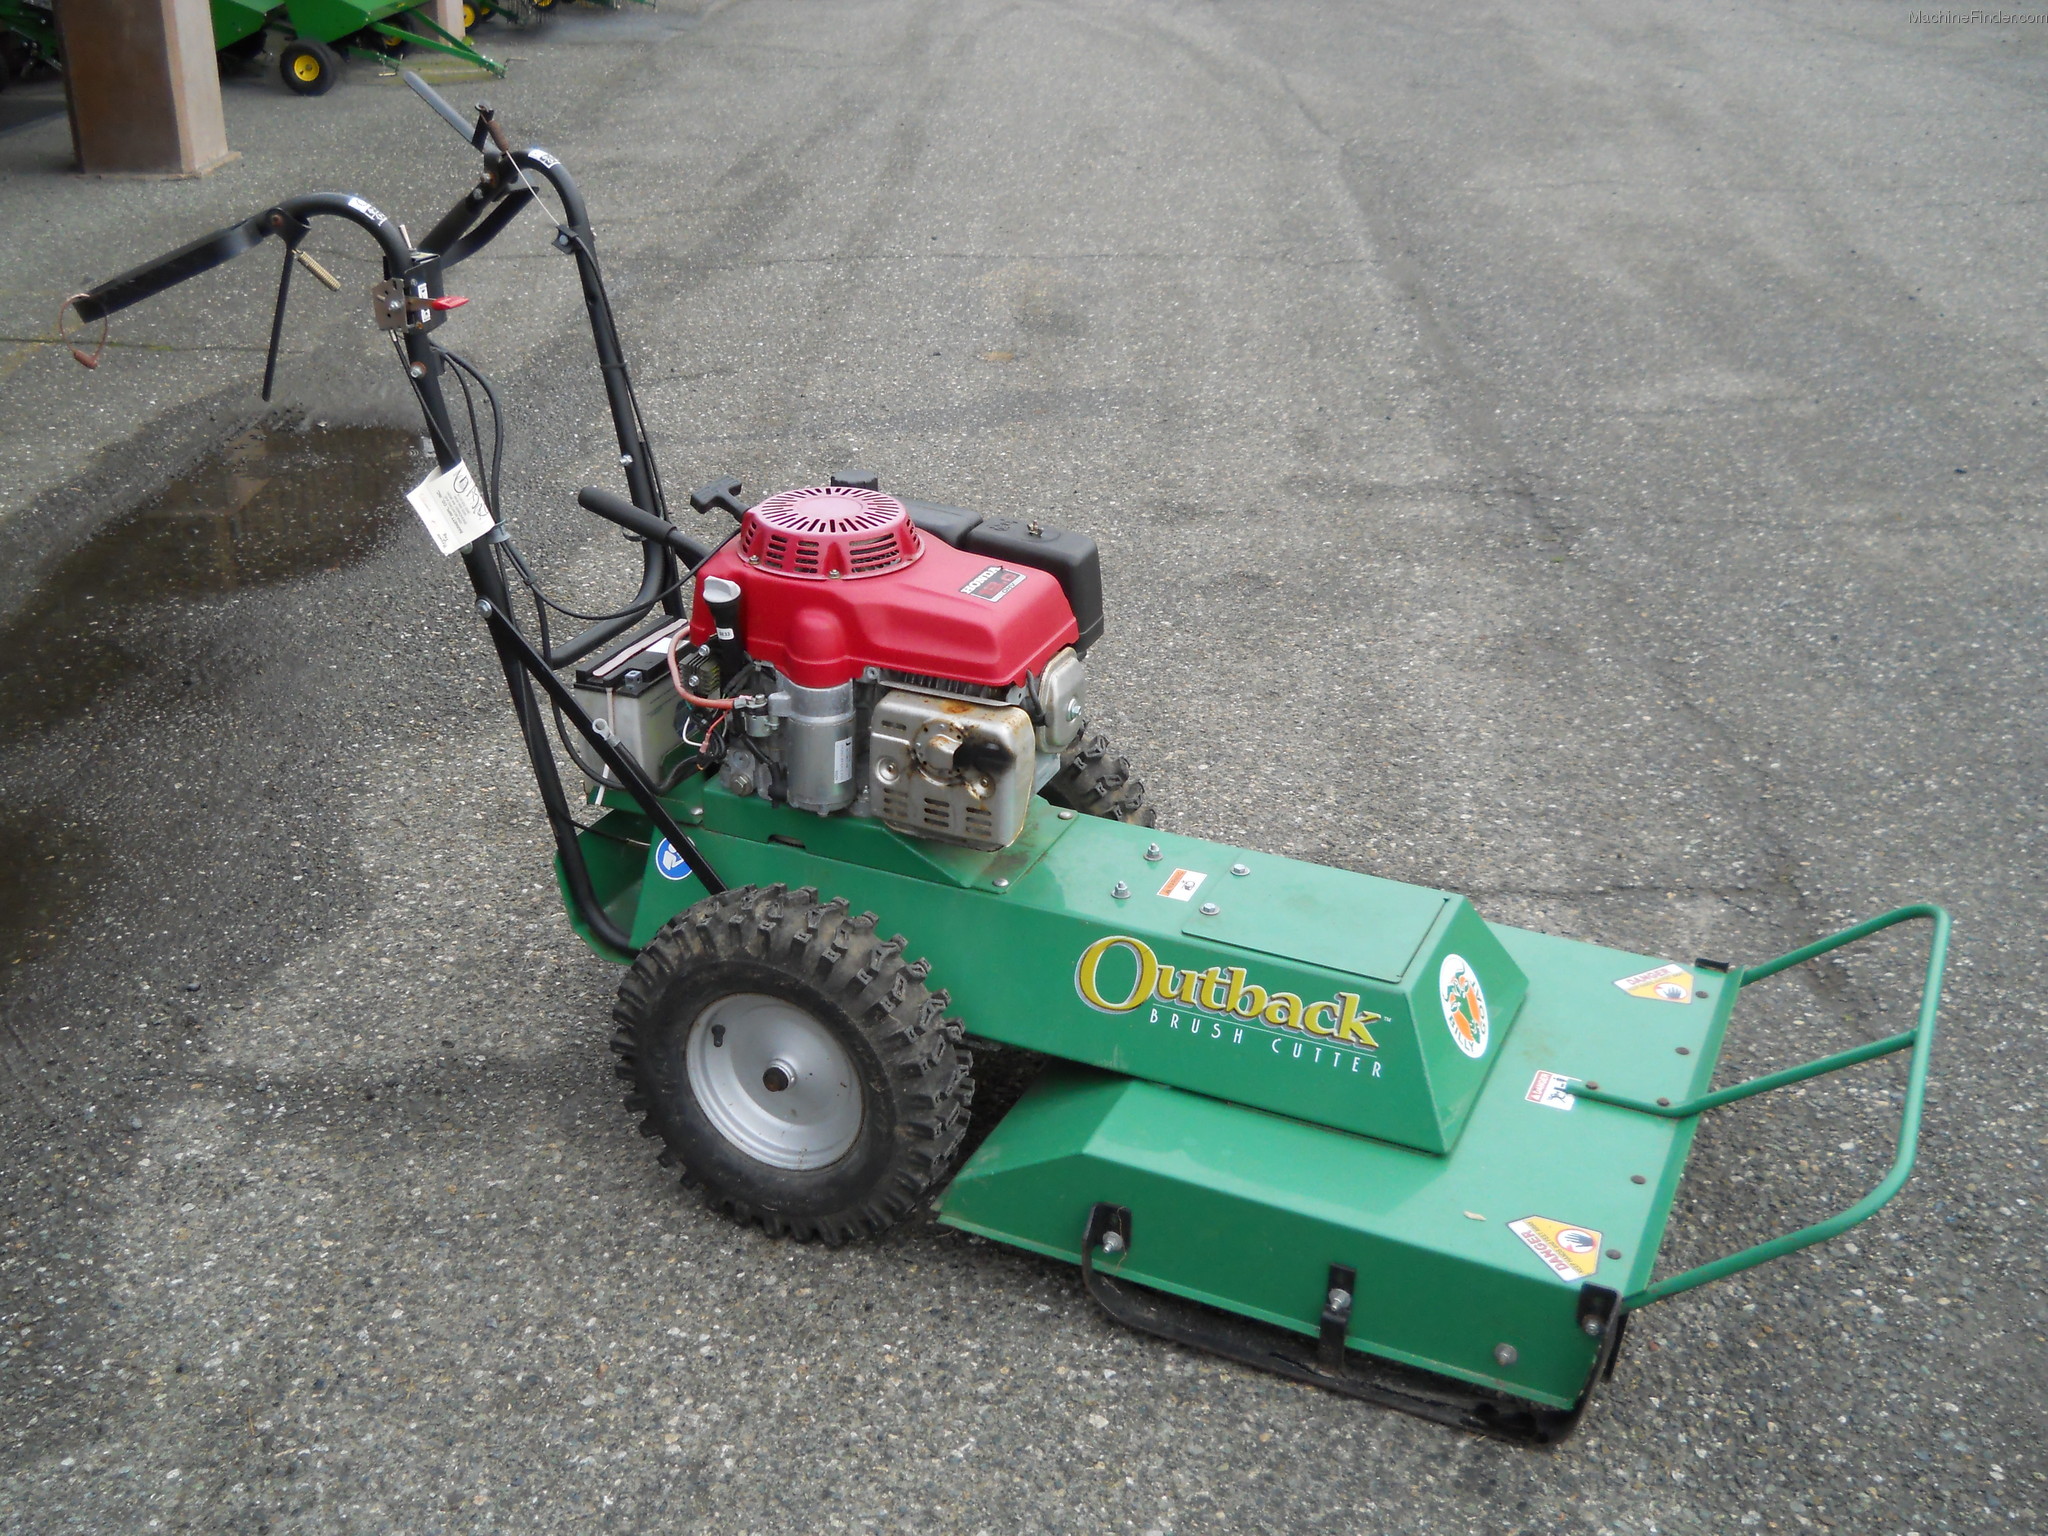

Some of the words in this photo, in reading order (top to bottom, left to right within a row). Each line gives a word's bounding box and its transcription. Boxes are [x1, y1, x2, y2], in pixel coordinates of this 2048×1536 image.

[960, 566, 1002, 594] HONDA
[1001, 582, 1017, 594] OHV
[1074, 935, 1382, 1051] Outback
[1625, 968, 1671, 986] DANGER
[1149, 1007, 1243, 1044] BRUSH
[1271, 1038, 1381, 1078] CUTTER
[1449, 1015, 1474, 1052] BILLY
[1520, 1230, 1569, 1271] DANGER
